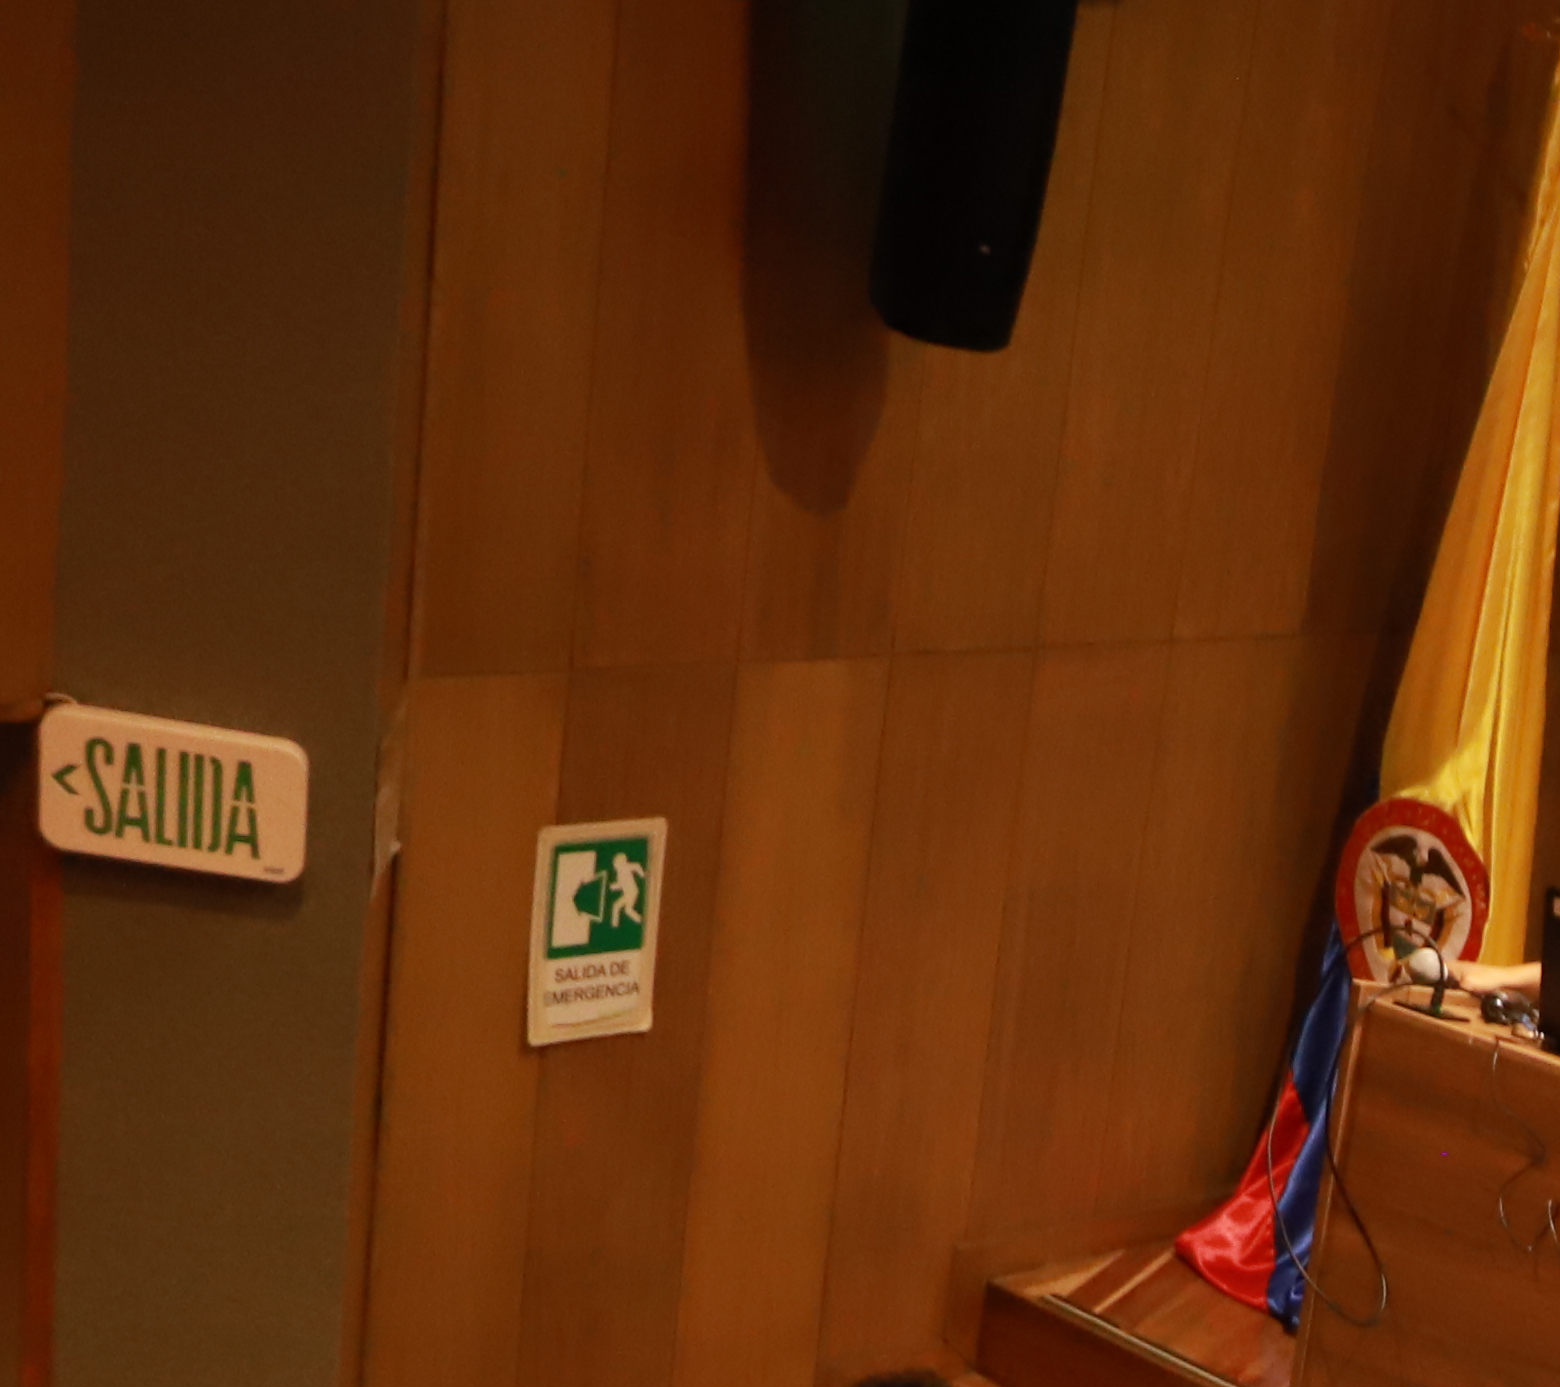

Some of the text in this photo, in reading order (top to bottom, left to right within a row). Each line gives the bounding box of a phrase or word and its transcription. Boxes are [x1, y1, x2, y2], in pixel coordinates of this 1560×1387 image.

[83, 737, 260, 860] SALIDA
[555, 960, 630, 982] SALIDA DE
[543, 981, 639, 1006] EMERGENCIA
